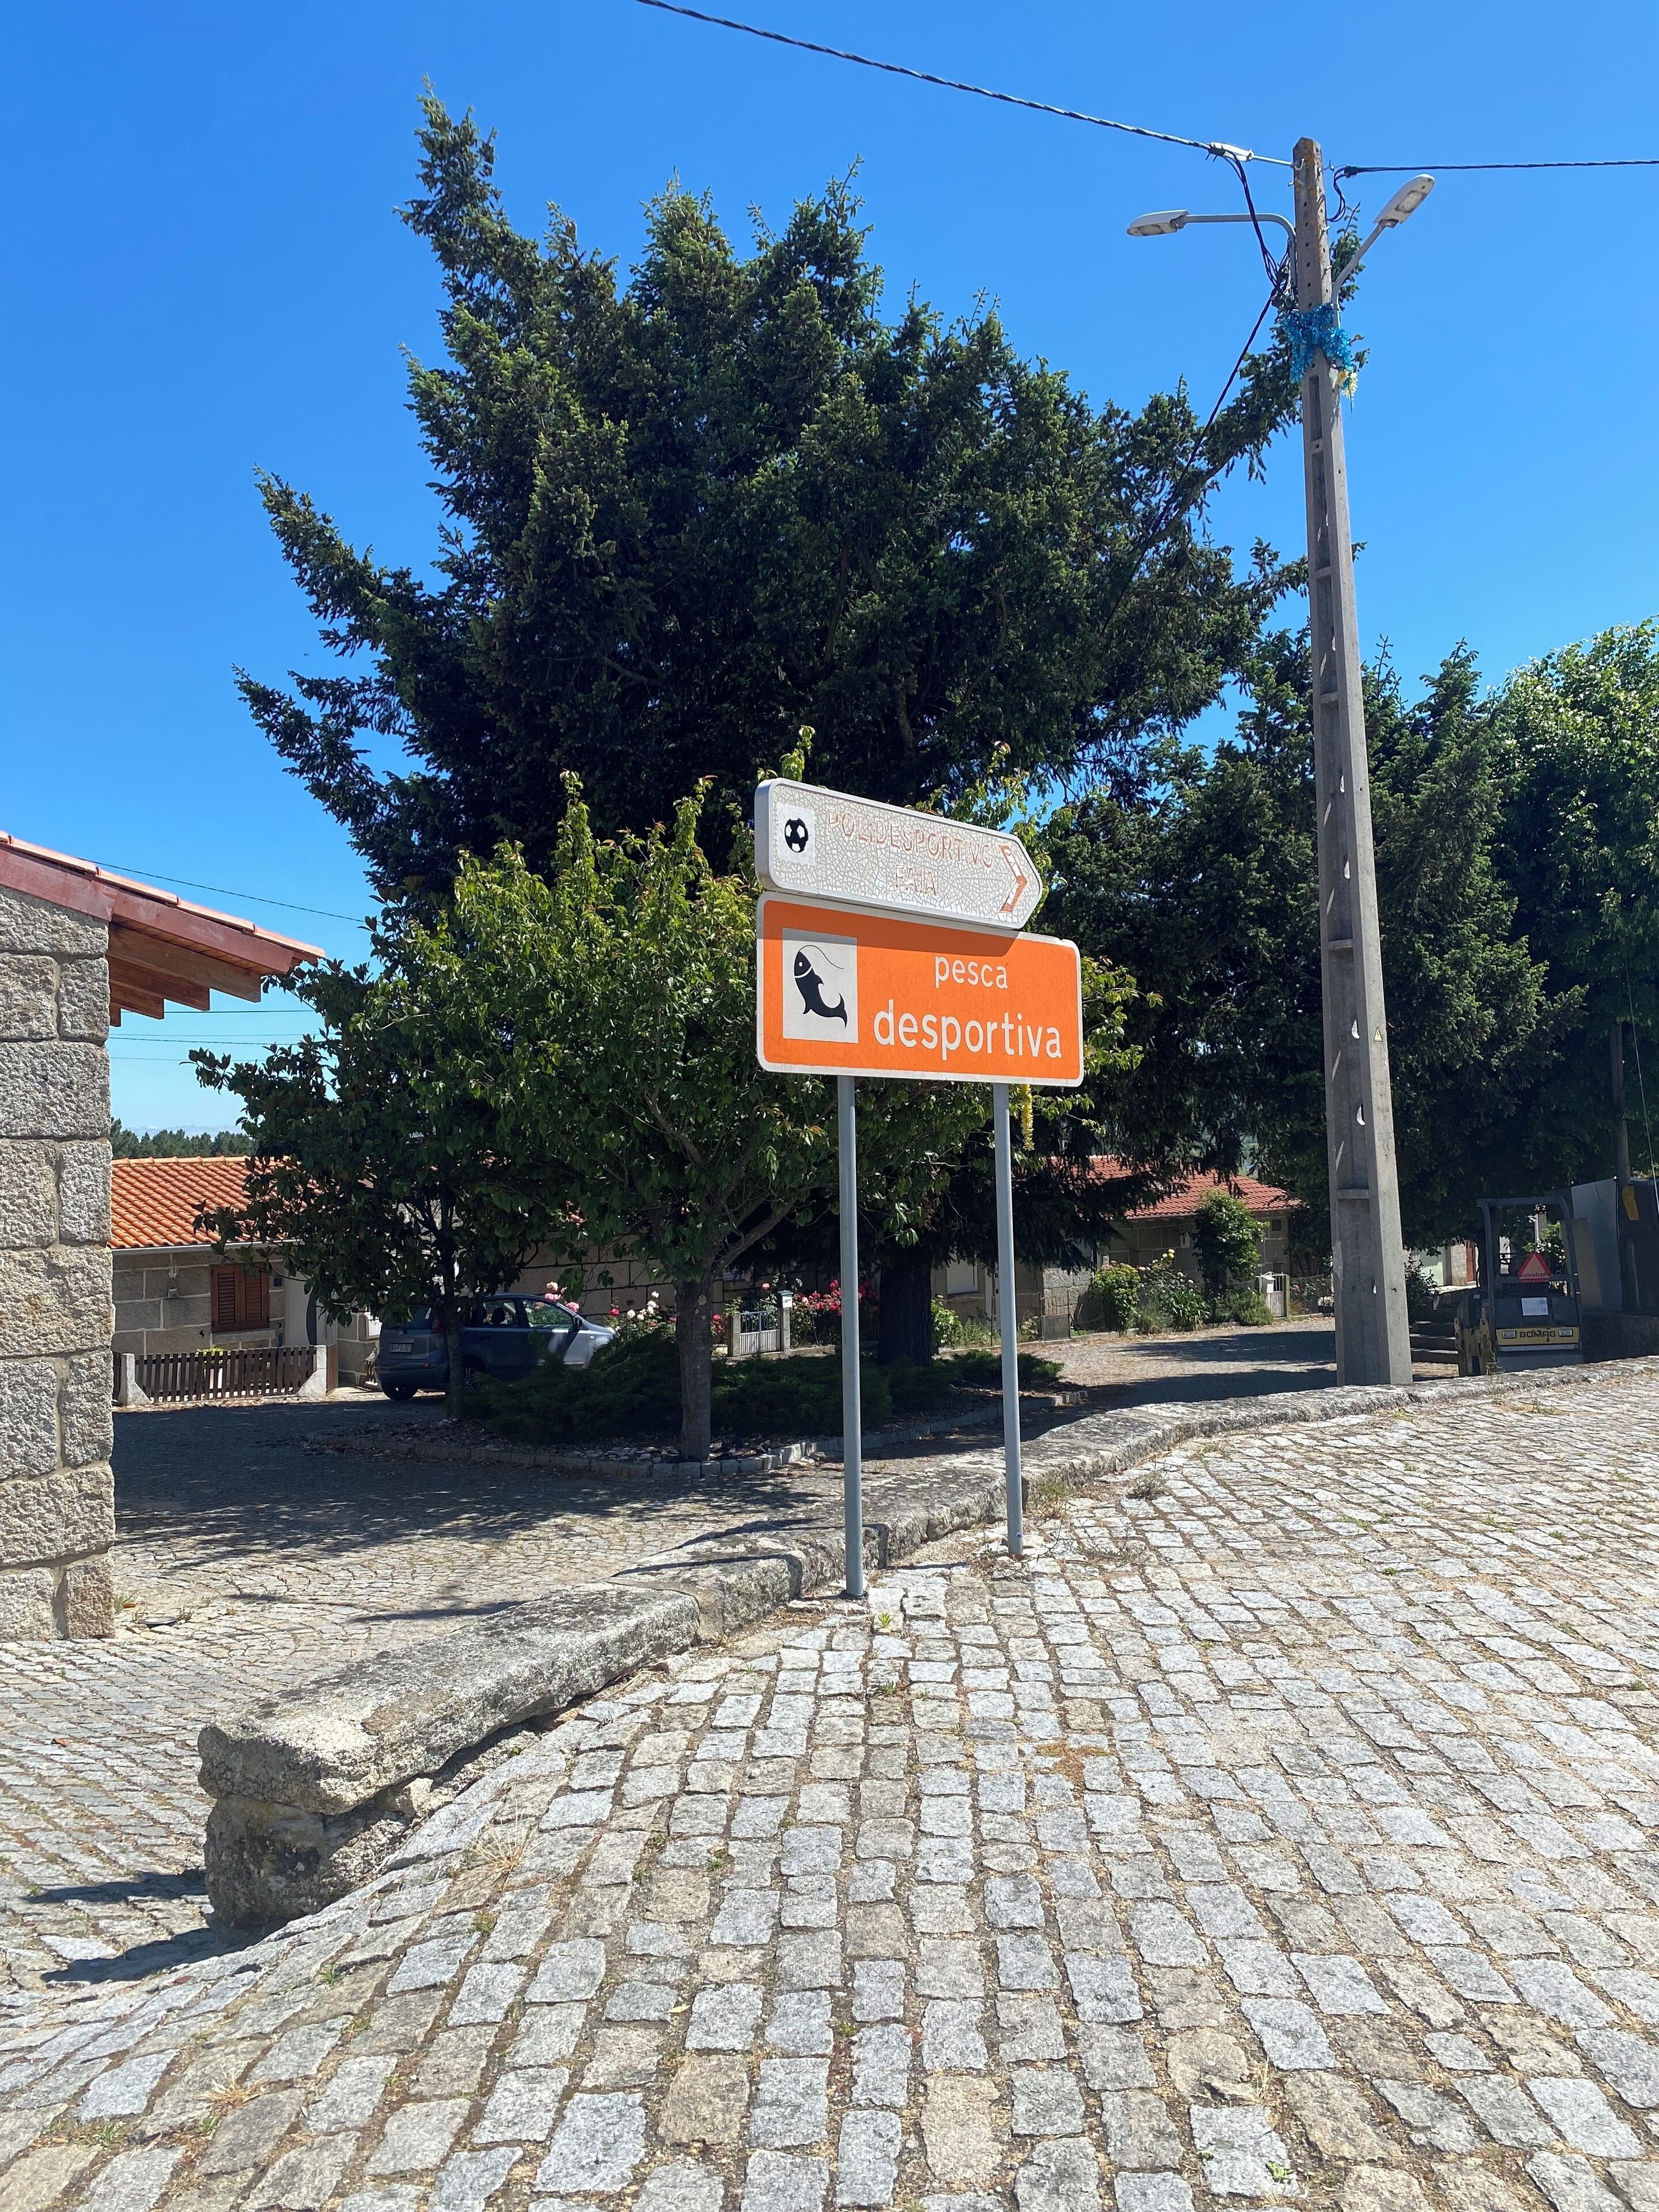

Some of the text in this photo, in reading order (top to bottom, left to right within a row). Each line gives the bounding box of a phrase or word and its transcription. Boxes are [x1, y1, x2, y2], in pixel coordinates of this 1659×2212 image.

[827, 808, 993, 868] POLIDESPORTIVO
[895, 864, 937, 896] FAIA
[935, 956, 1008, 989] pesca
[873, 999, 1062, 1060] desportiva
